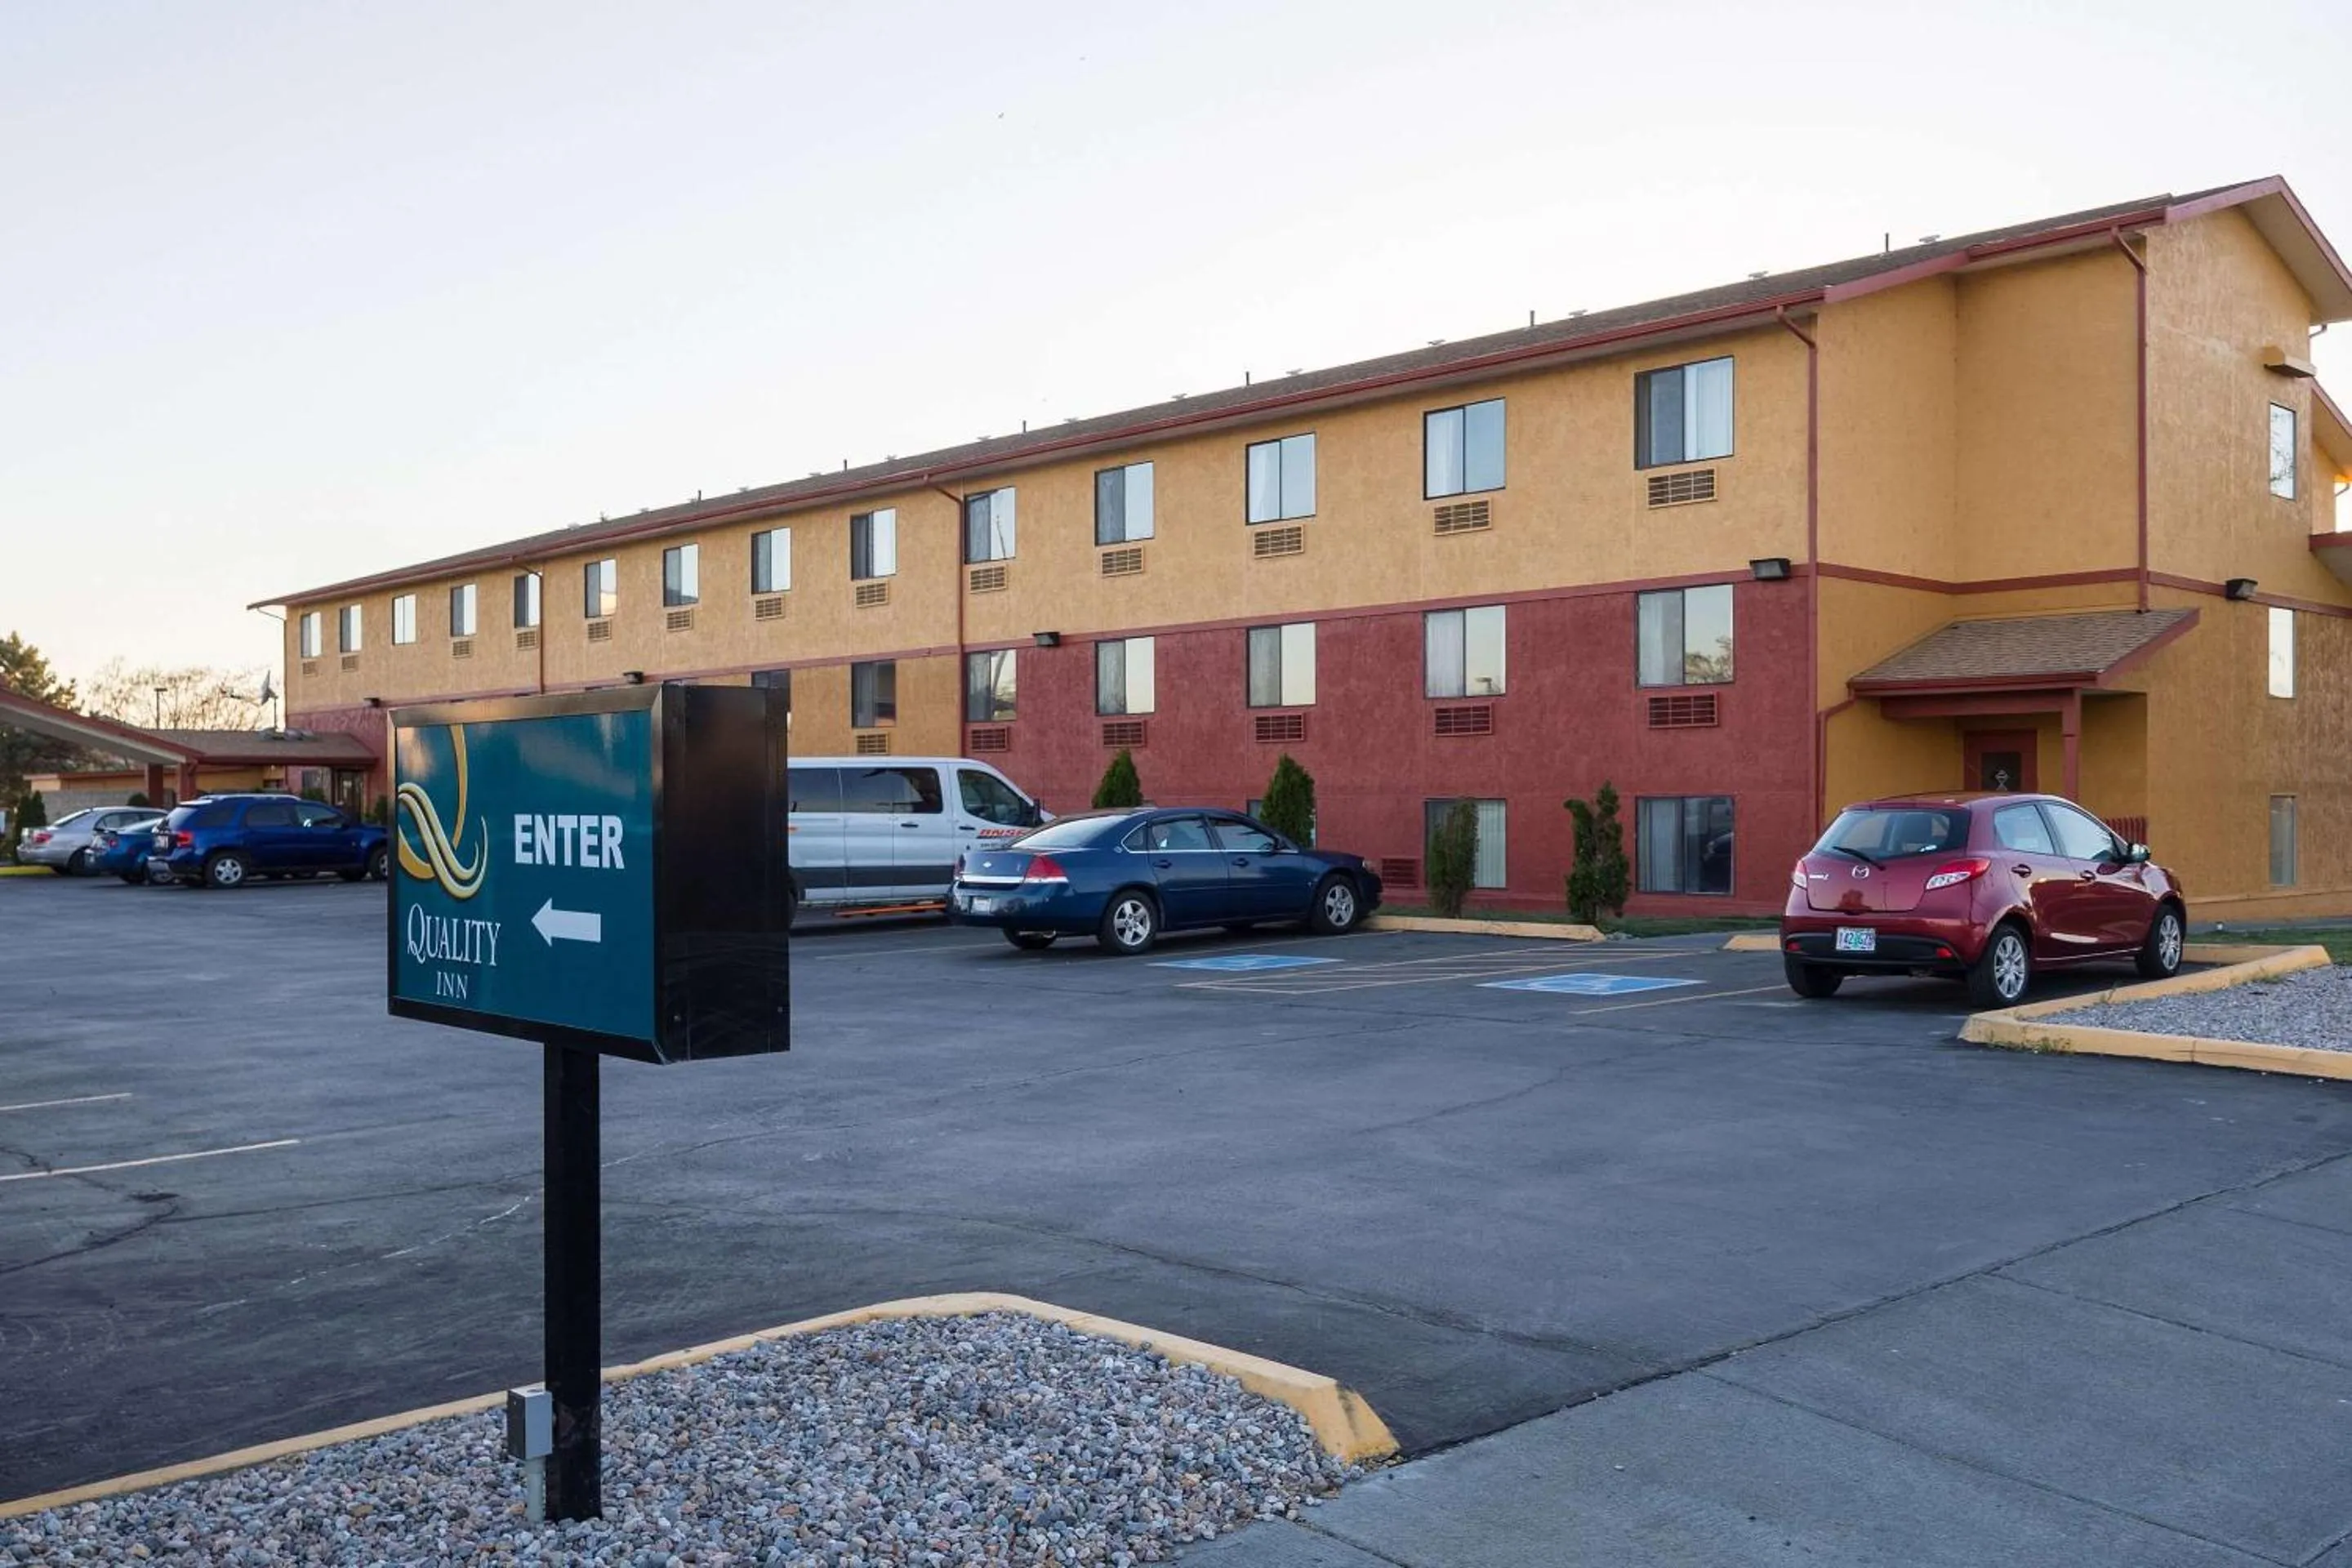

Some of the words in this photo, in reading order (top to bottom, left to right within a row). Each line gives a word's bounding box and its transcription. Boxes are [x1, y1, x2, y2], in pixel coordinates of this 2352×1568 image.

[514, 813, 625, 870] ENTER
[408, 902, 501, 966] QUALITY
[435, 970, 468, 1000] INN
